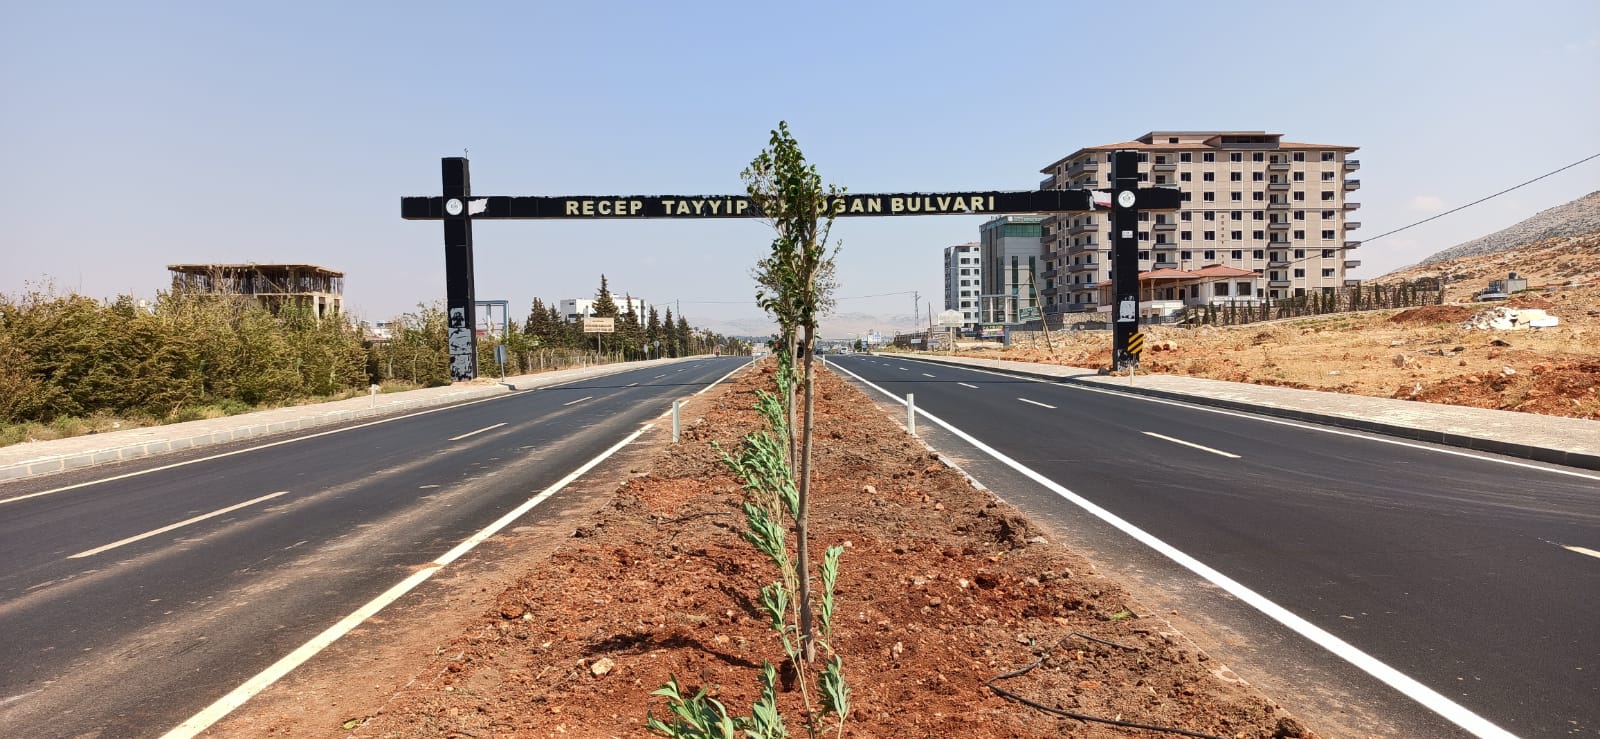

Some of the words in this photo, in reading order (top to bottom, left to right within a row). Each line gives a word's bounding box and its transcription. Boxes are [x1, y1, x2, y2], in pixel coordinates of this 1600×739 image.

[566, 200, 643, 215] RECEP
[662, 196, 748, 215] TAYYİP
[891, 196, 994, 212] BULVARI
